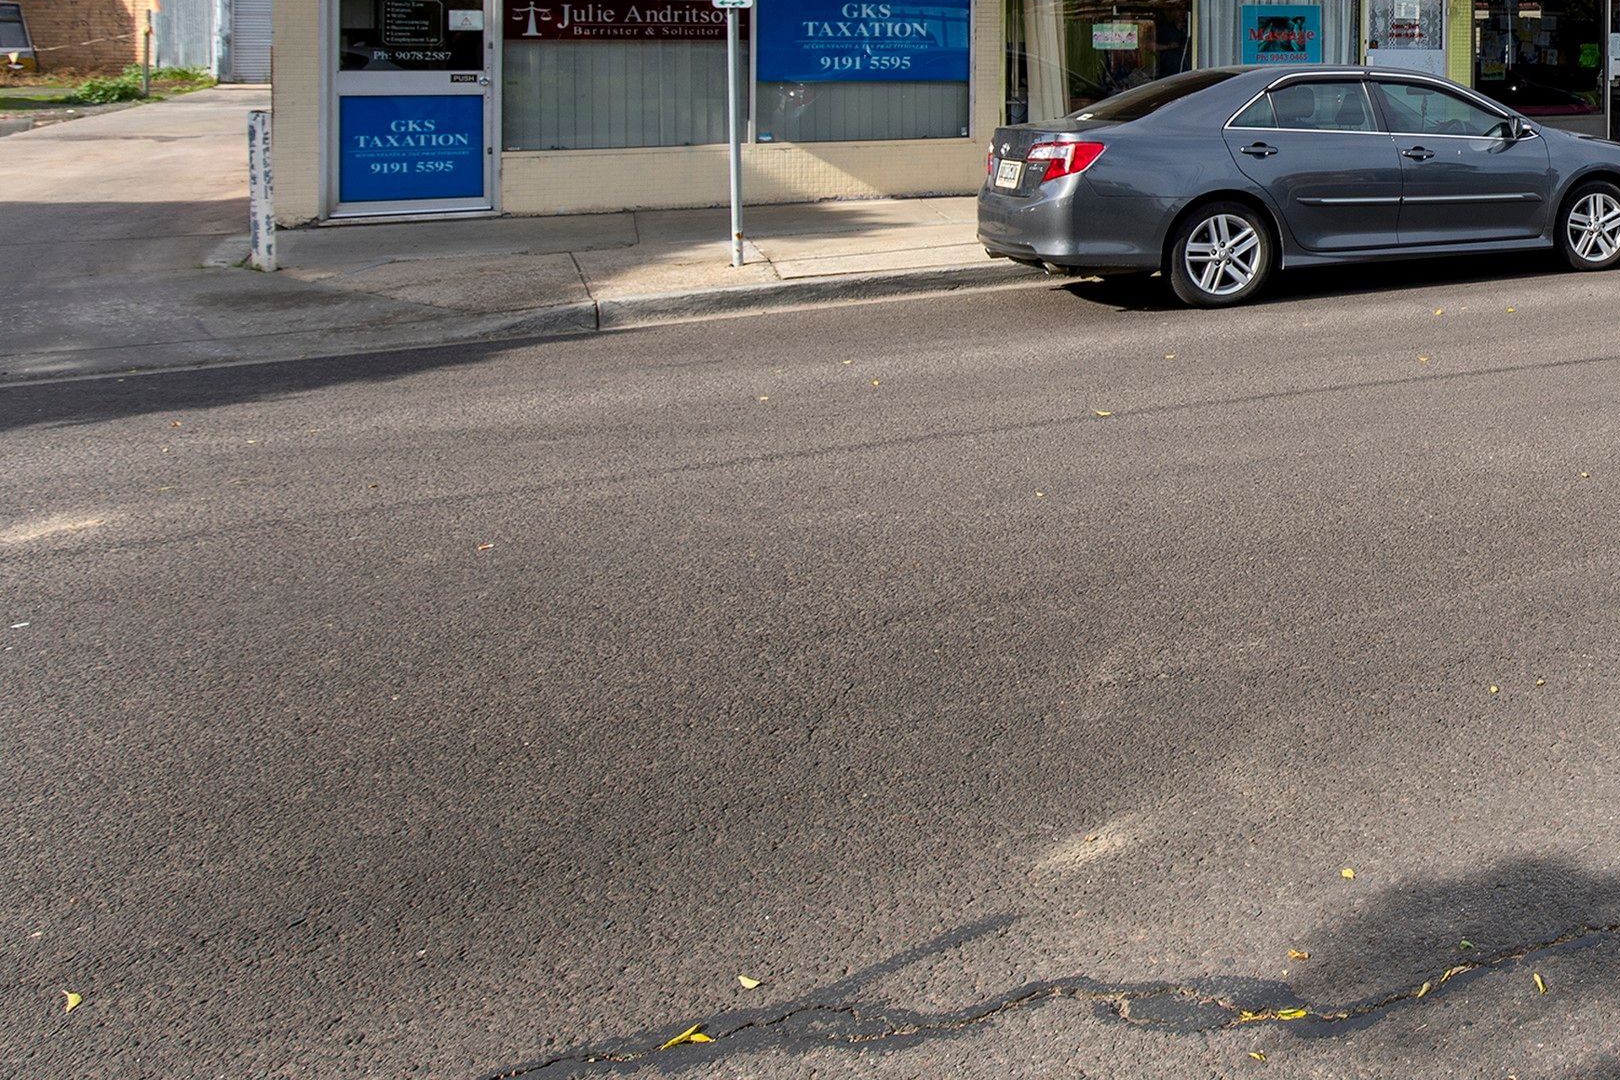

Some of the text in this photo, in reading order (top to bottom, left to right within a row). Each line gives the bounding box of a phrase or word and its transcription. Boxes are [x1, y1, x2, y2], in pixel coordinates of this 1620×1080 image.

[557, 3, 615, 29] Julie
[842, 3, 891, 19] GKS
[573, 26, 721, 36] Barrister & Solicitor
[803, 21, 929, 38] TAXATION
[1249, 28, 1315, 44] Massage
[373, 51, 392, 61] Ph:
[1271, 53, 1288, 62] 9943
[1290, 53, 1308, 62] 0465
[820, 56, 912, 70] 9191 5595
[453, 74, 475, 82] PUSH
[390, 120, 436, 133] GKS
[354, 133, 470, 148] TAXATION
[371, 161, 454, 174] 9191 5595
